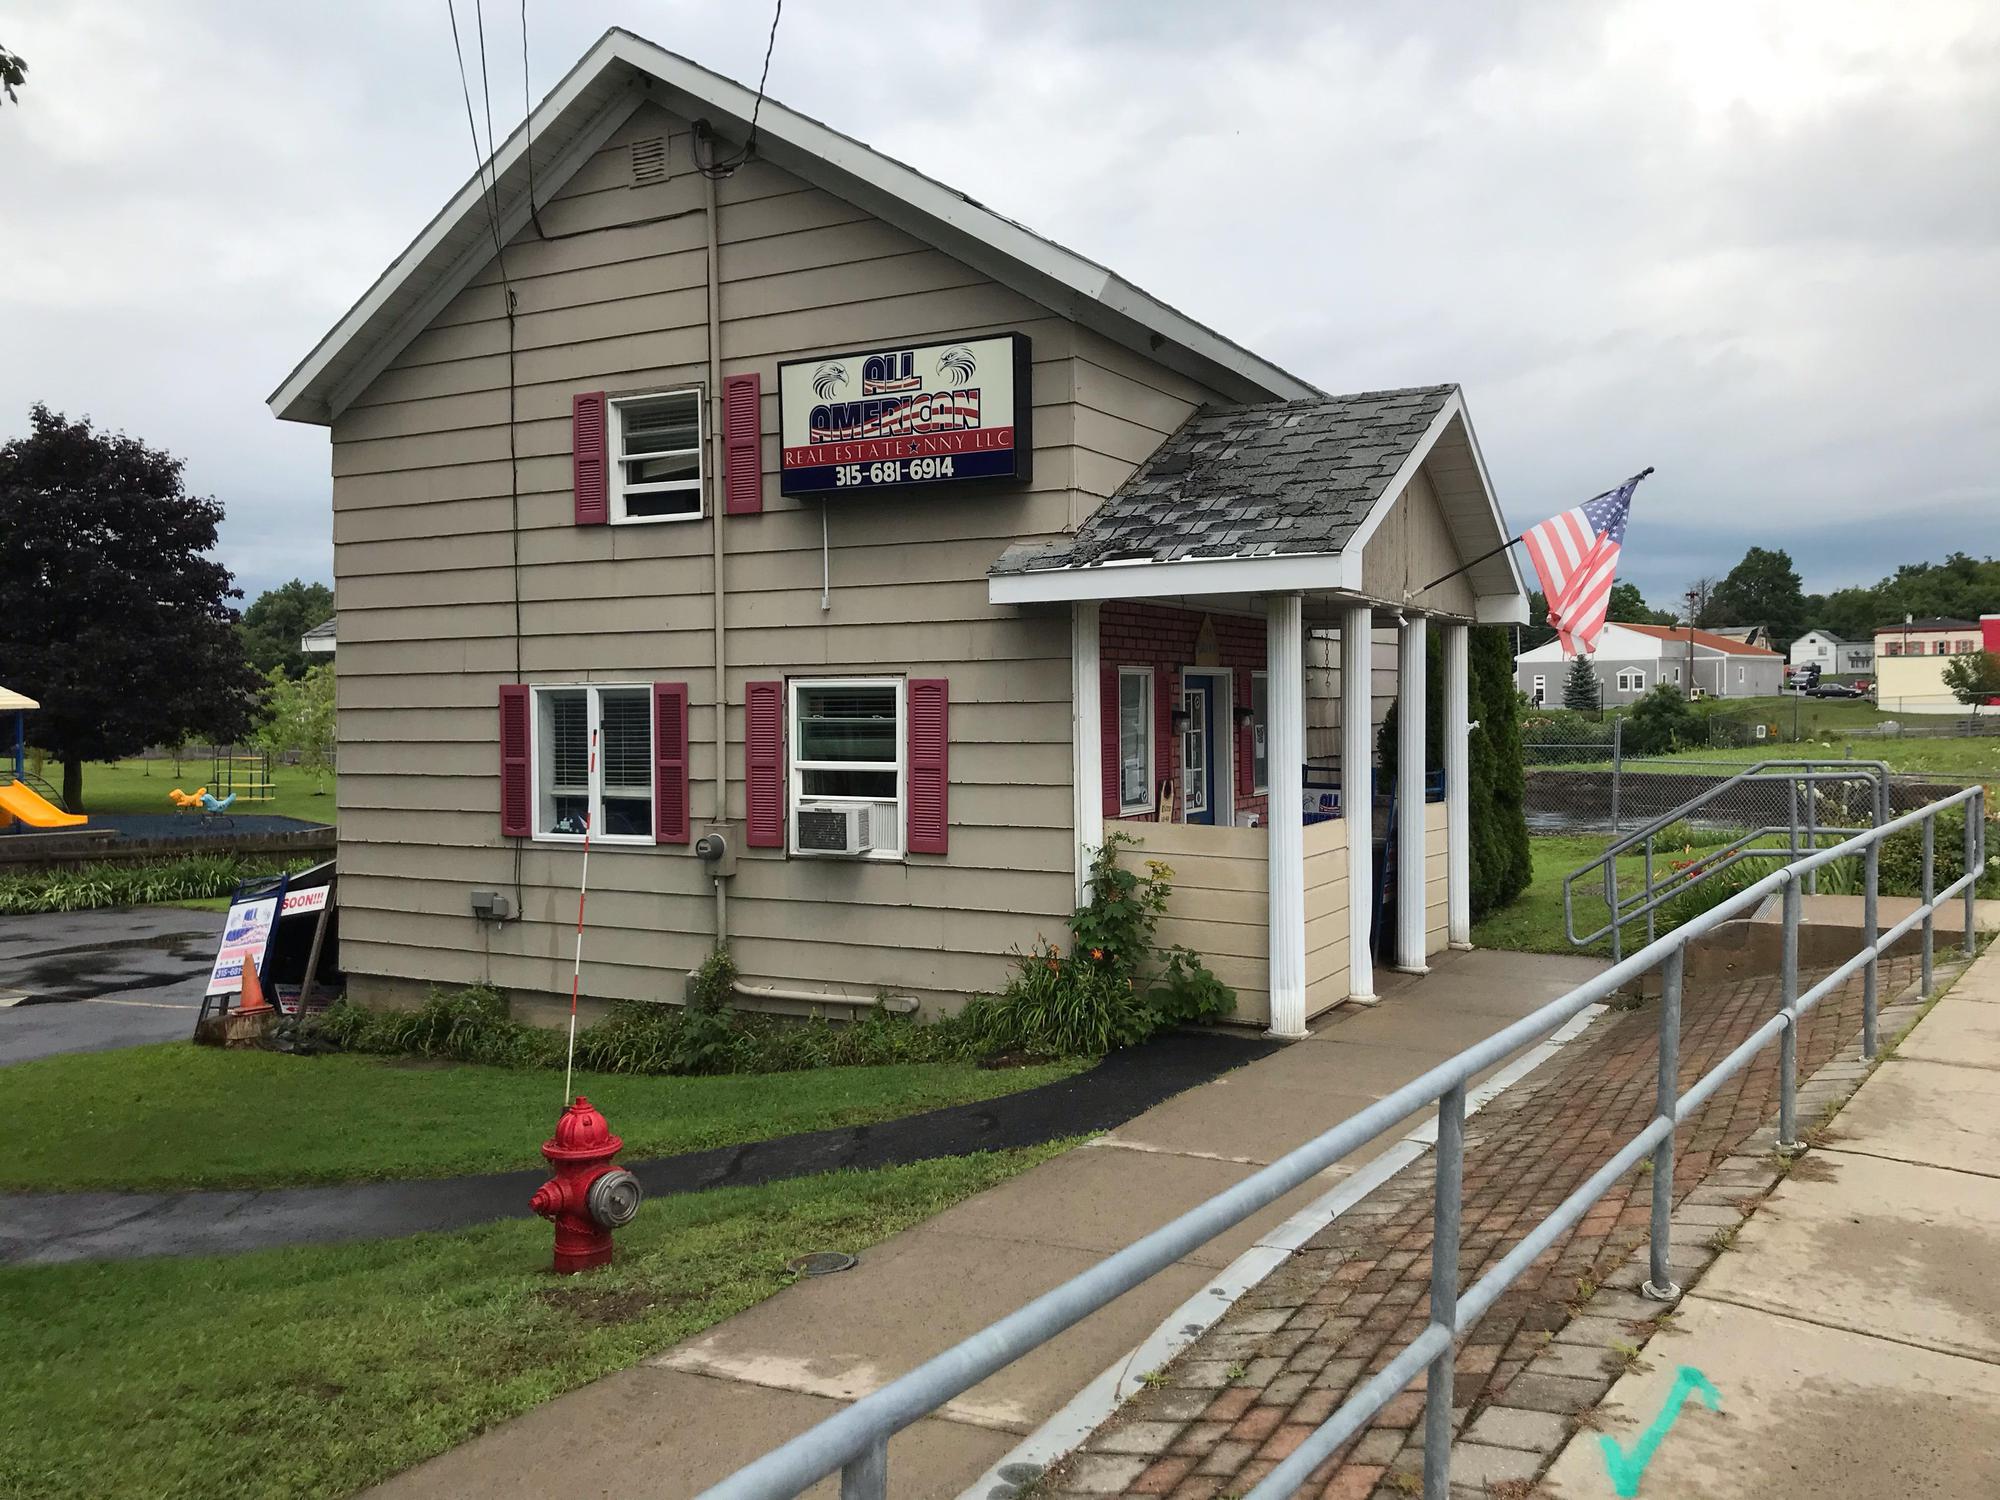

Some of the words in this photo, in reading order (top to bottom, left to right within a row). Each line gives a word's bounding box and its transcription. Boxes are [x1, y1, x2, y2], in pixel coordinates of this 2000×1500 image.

[863, 352, 922, 396] ALL
[810, 388, 980, 444] AMERICAN
[785, 448, 826, 465] REAL
[835, 441, 902, 461] ESTATE
[924, 434, 965, 452] NNY
[976, 430, 1009, 448] LLC
[835, 456, 954, 486] 315-681-6914
[282, 892, 324, 910] SOON!!!
